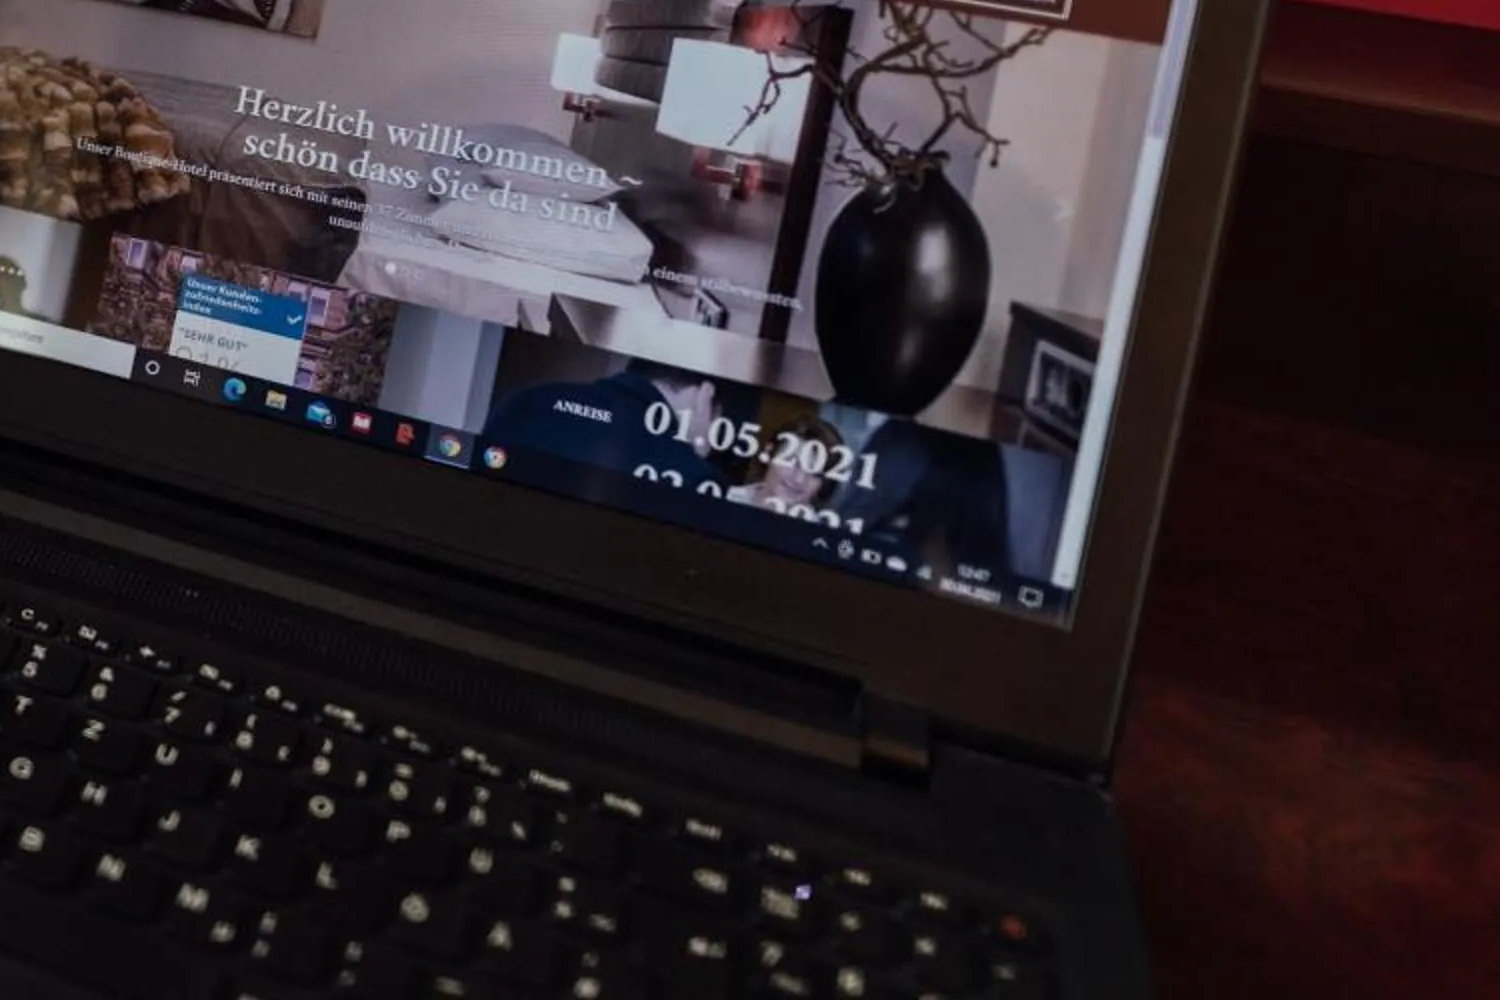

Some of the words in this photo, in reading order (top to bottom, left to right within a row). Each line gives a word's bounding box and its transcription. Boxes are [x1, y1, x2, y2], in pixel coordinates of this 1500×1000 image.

[76, 136, 112, 157] Unser
[208, 167, 277, 194] präsentiert
[278, 180, 305, 200] sich
[306, 187, 329, 205] mit
[236, 84, 376, 140] Herzlich
[387, 122, 609, 190] willkommen
[243, 128, 340, 177] schön
[348, 151, 420, 190] dass
[427, 165, 480, 202] Sie
[488, 180, 528, 213] da
[539, 190, 618, 233] sind
[553, 398, 613, 424] ANREISE
[643, 400, 880, 490] 01.05.2021
